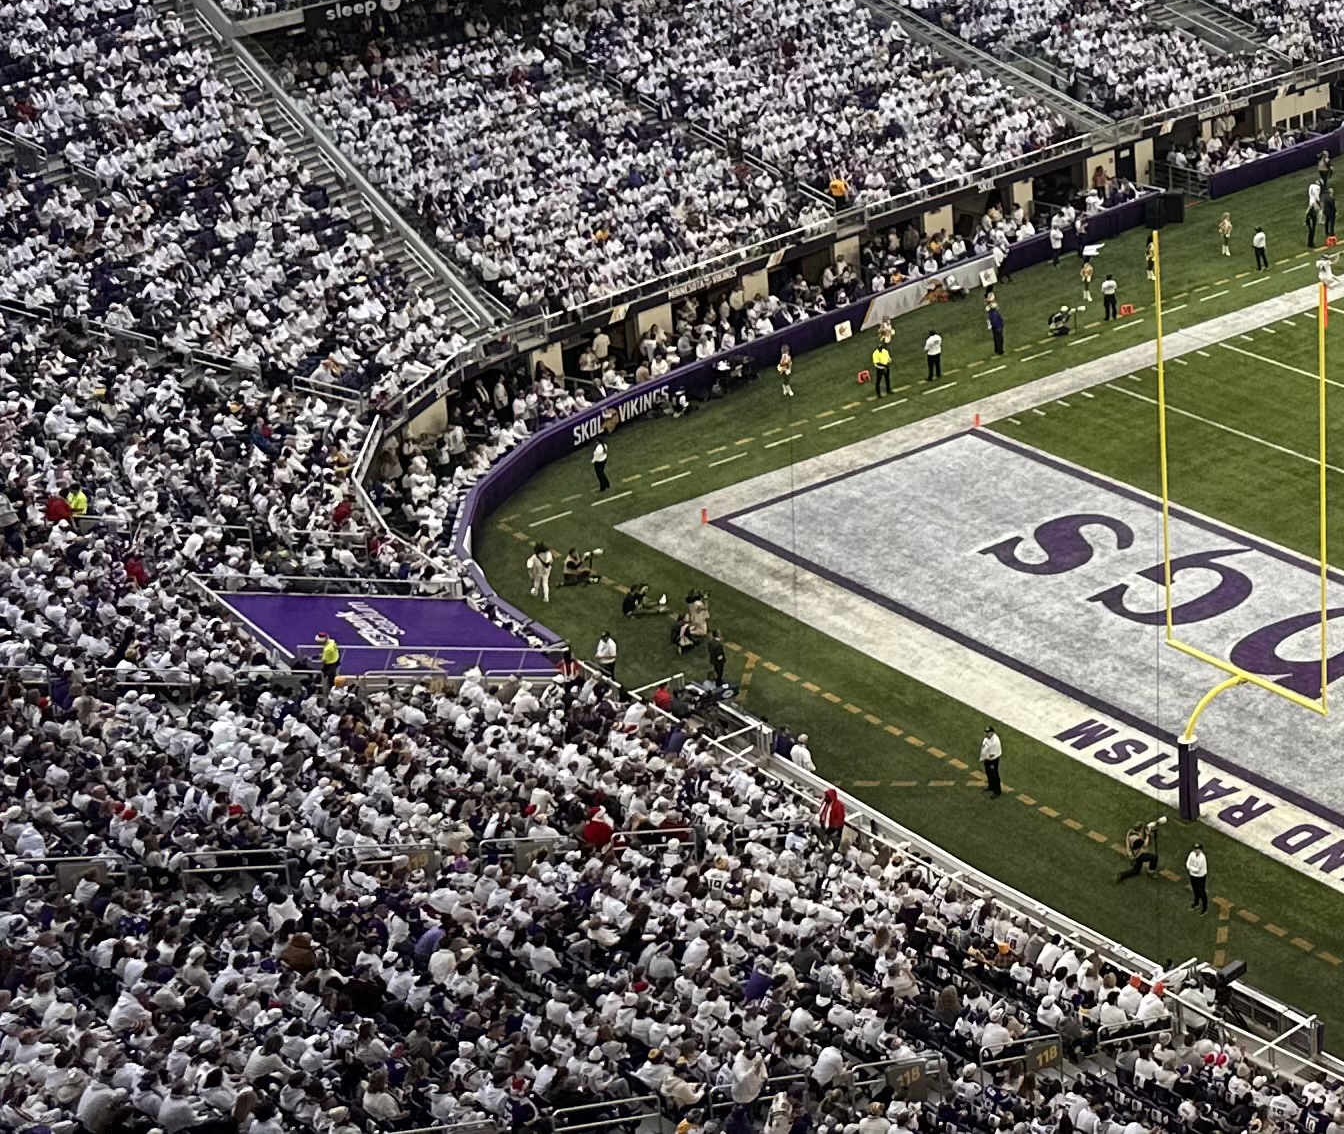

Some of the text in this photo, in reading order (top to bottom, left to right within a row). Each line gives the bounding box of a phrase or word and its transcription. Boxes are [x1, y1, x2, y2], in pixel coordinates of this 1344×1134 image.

[326, 0, 378, 26] sleep
[573, 415, 605, 446] SKOL
[1053, 717, 1276, 829] RACISM
